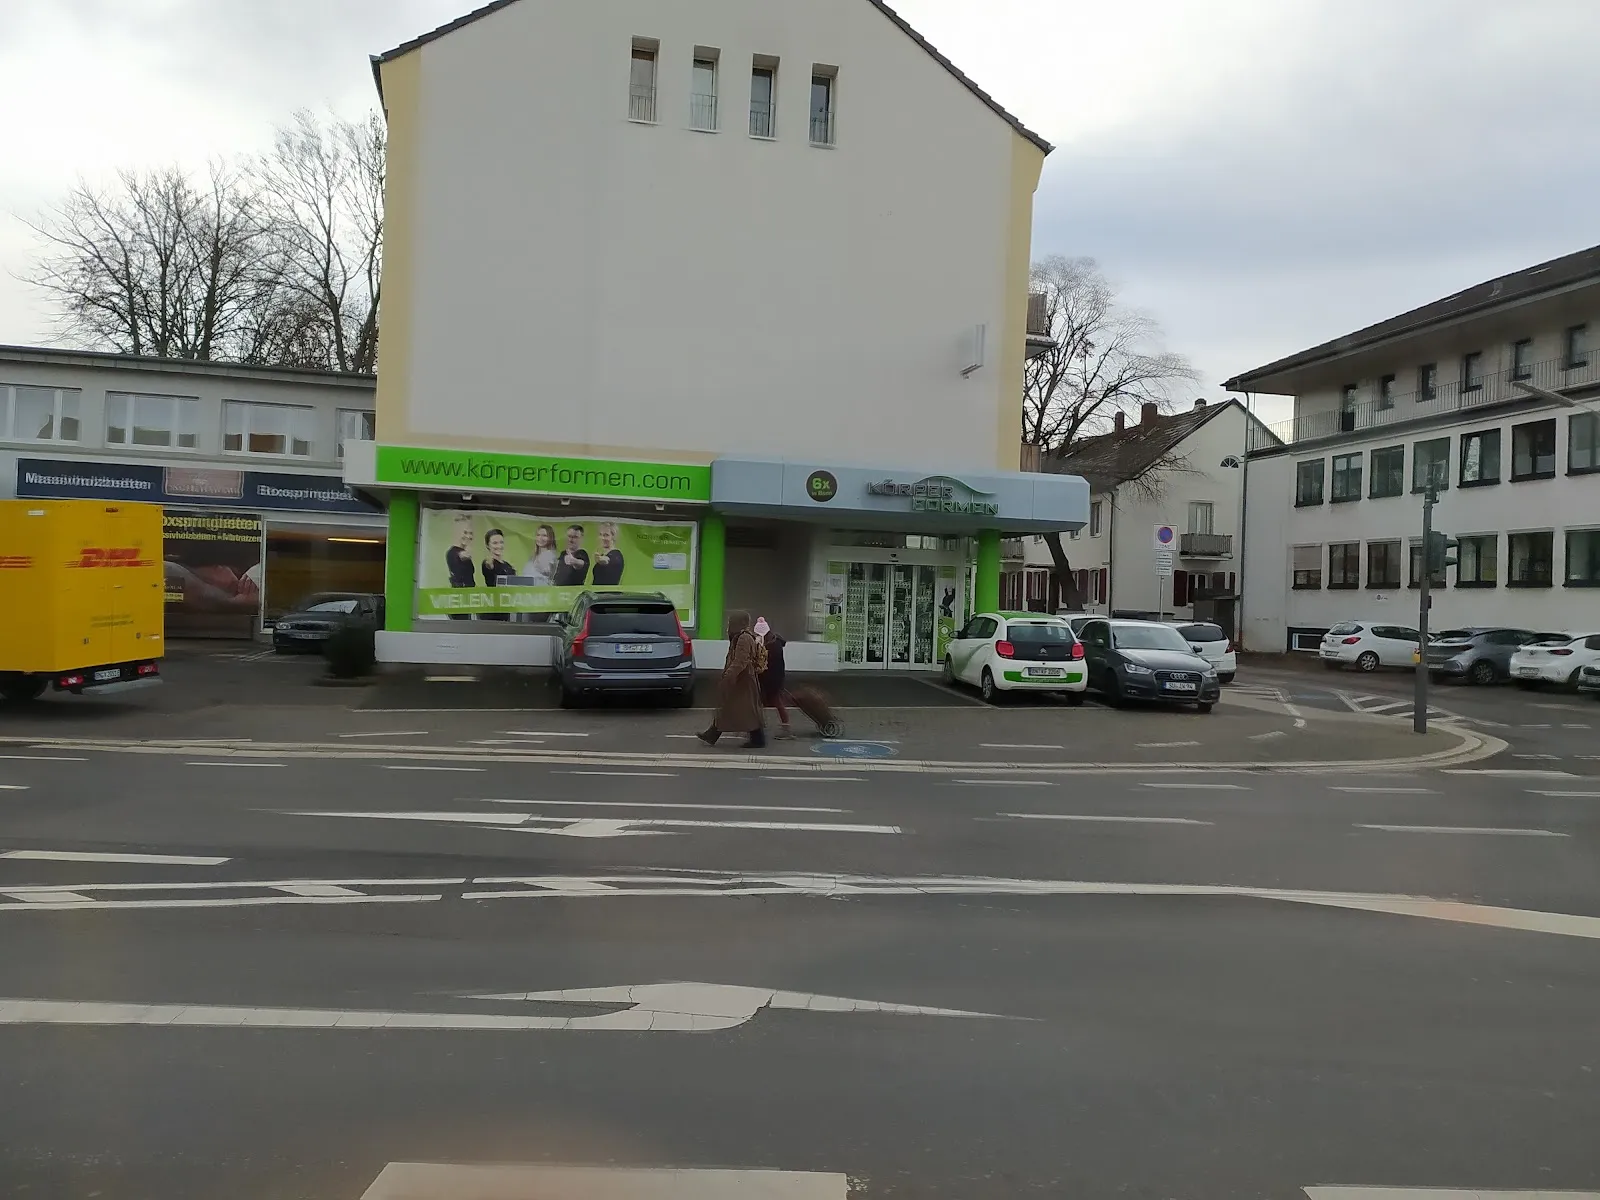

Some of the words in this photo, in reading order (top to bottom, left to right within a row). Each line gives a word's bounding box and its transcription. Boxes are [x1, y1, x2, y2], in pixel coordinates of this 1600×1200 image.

[400, 457, 691, 490] www.körperformen.com
[812, 477, 831, 490] 6x
[867, 478, 954, 499] KÖRPER
[912, 497, 999, 515] FORMEN
[163, 516, 262, 531] oxspringbetten
[79, 548, 141, 568] DHL
[429, 593, 495, 609] VIELEN
